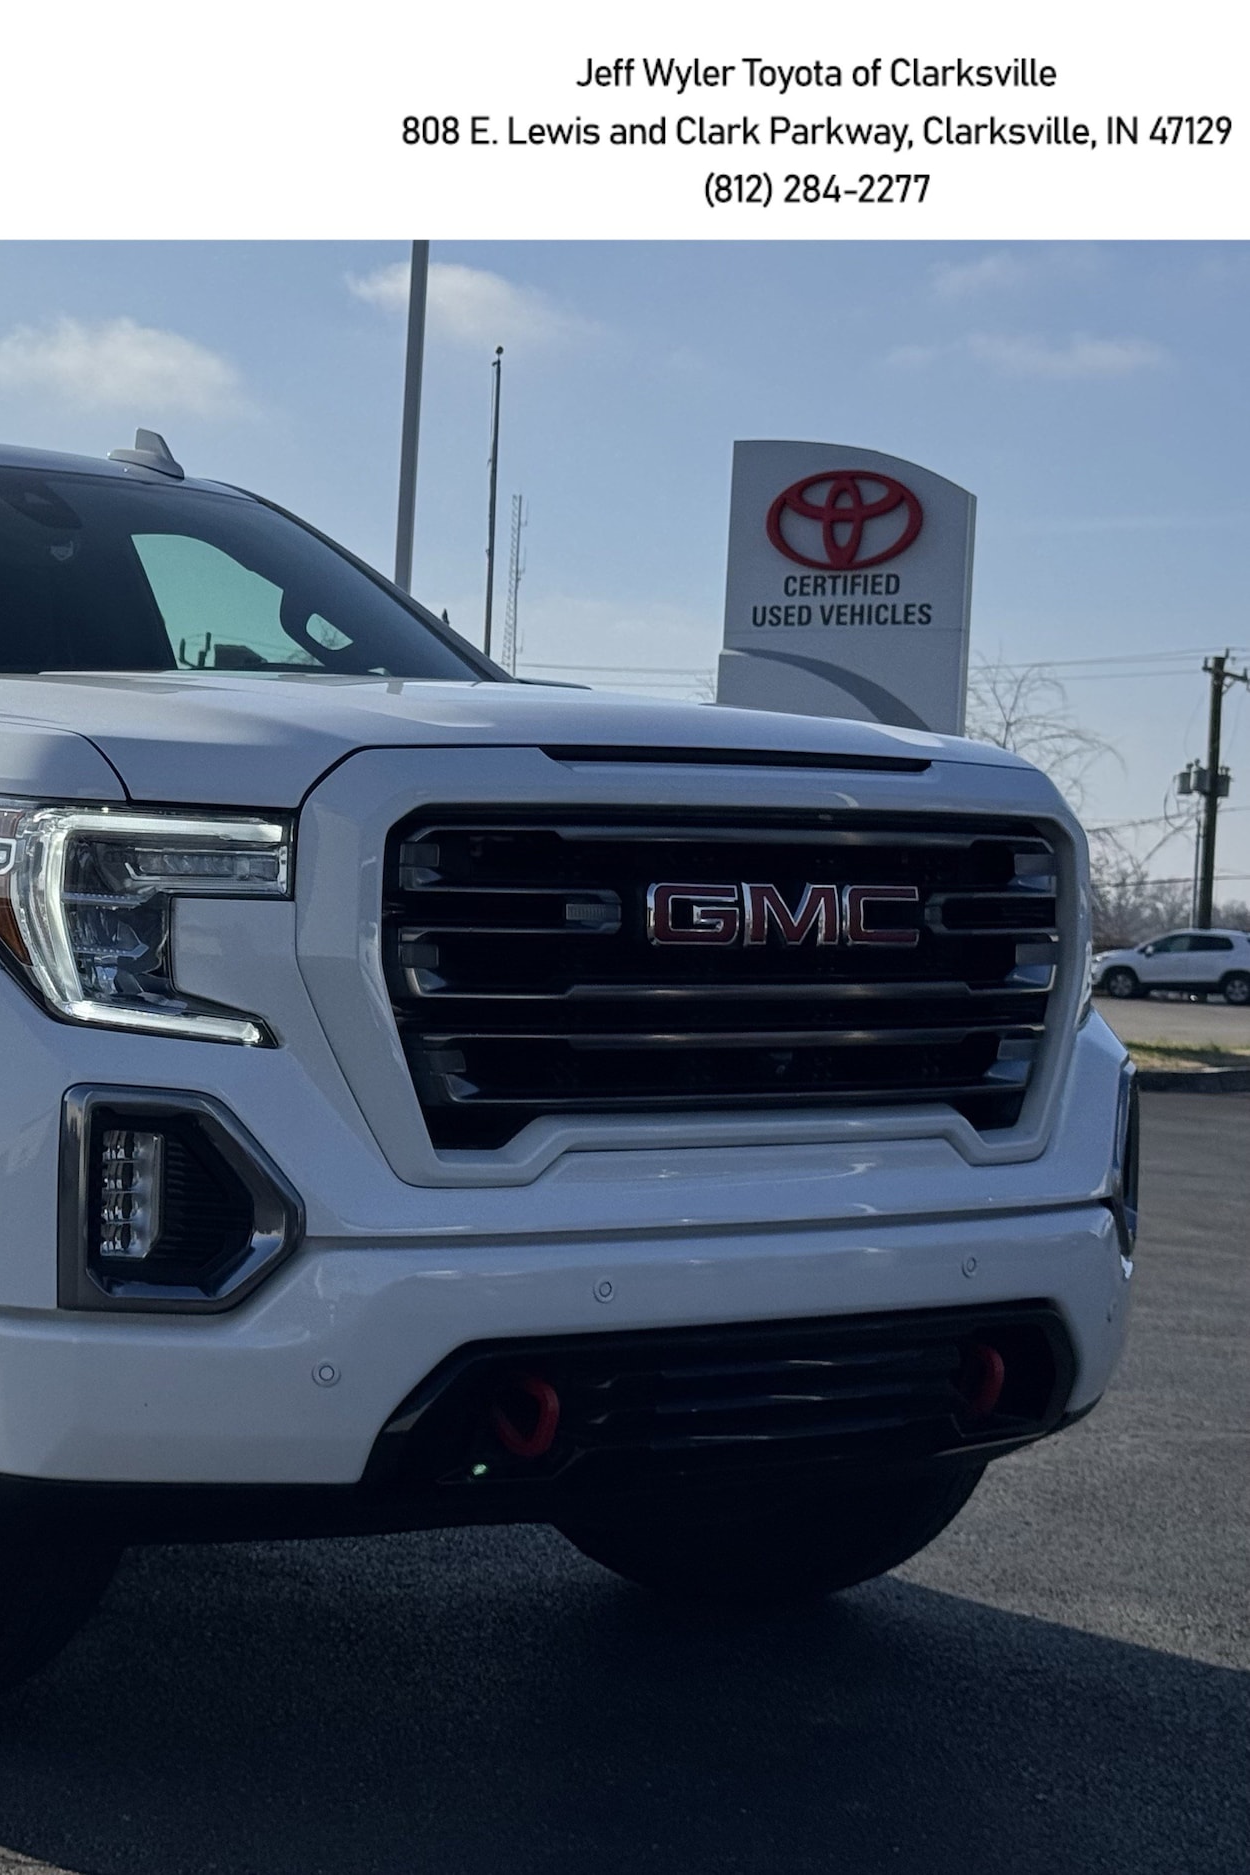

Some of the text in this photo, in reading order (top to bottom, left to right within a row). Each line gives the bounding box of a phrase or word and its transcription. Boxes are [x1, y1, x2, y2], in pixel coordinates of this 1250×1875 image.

[783, 573, 901, 598] CERTIFIED
[751, 602, 933, 628] USED VEHICLES
[646, 881, 920, 947] GMC
